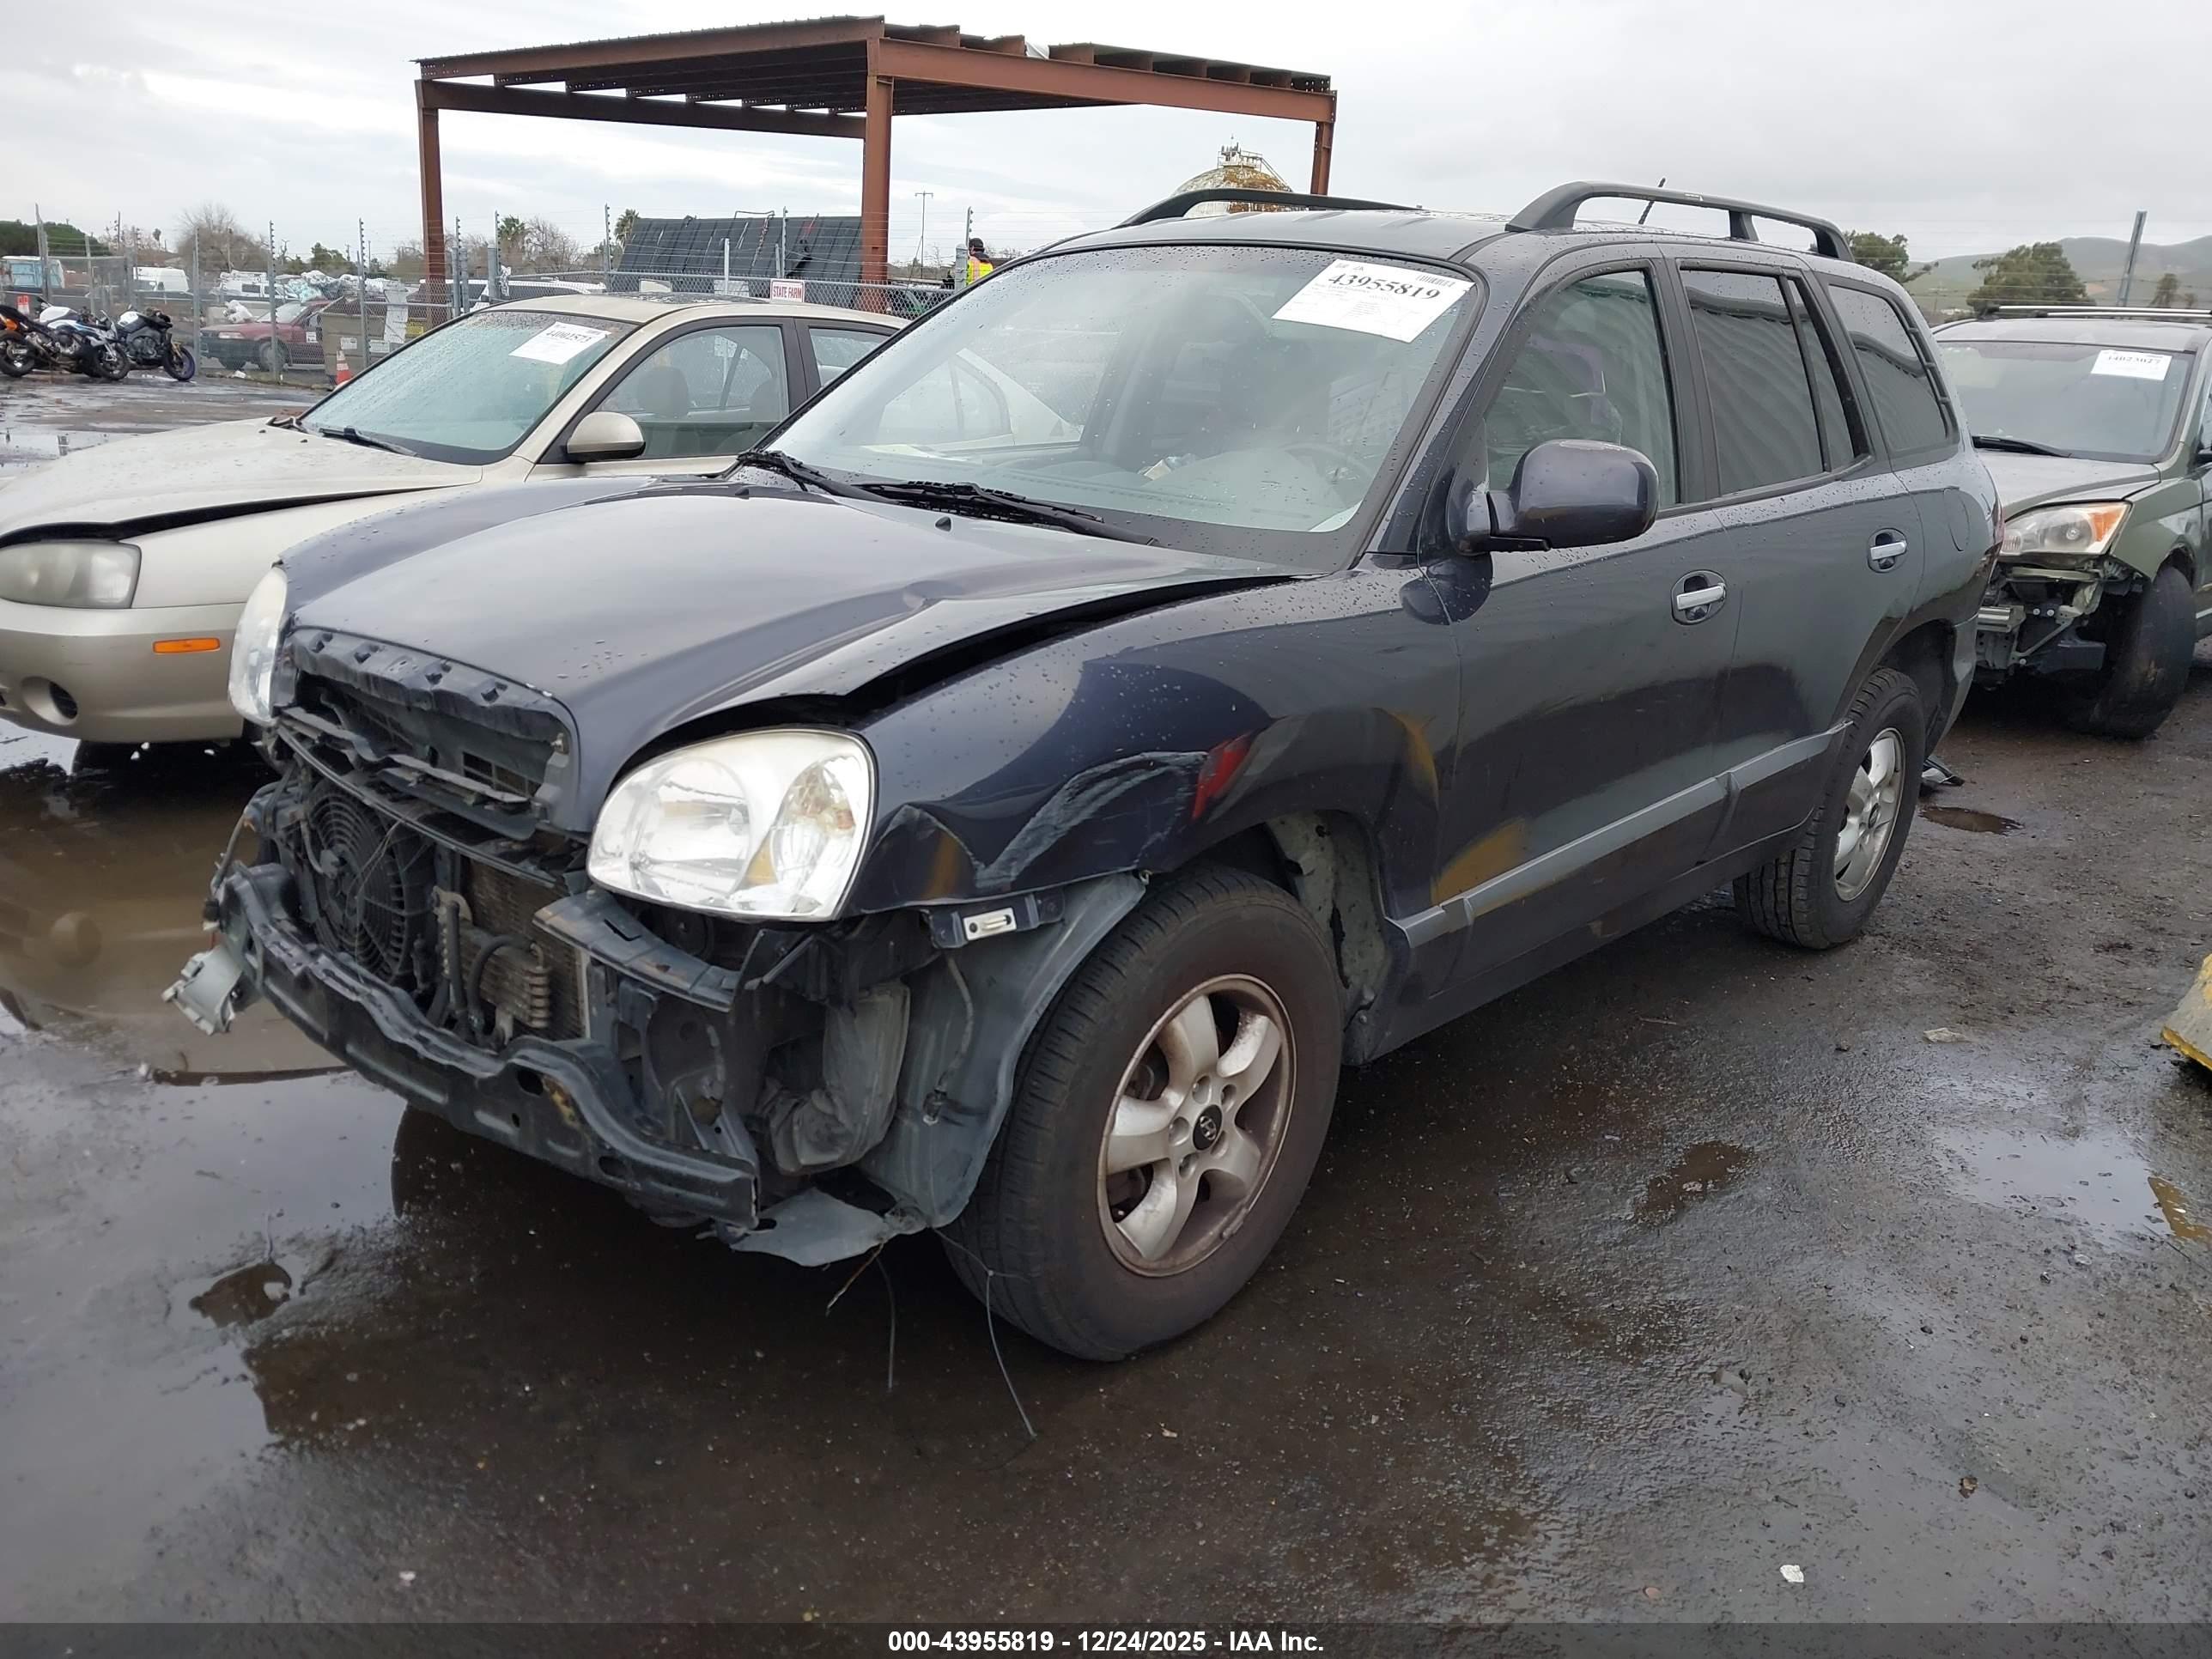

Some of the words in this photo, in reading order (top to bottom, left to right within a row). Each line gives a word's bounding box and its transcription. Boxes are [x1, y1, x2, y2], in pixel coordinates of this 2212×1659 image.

[773, 286, 787, 298] STATE
[787, 287, 802, 299] FARM
[1328, 272, 1442, 300] 43955819
